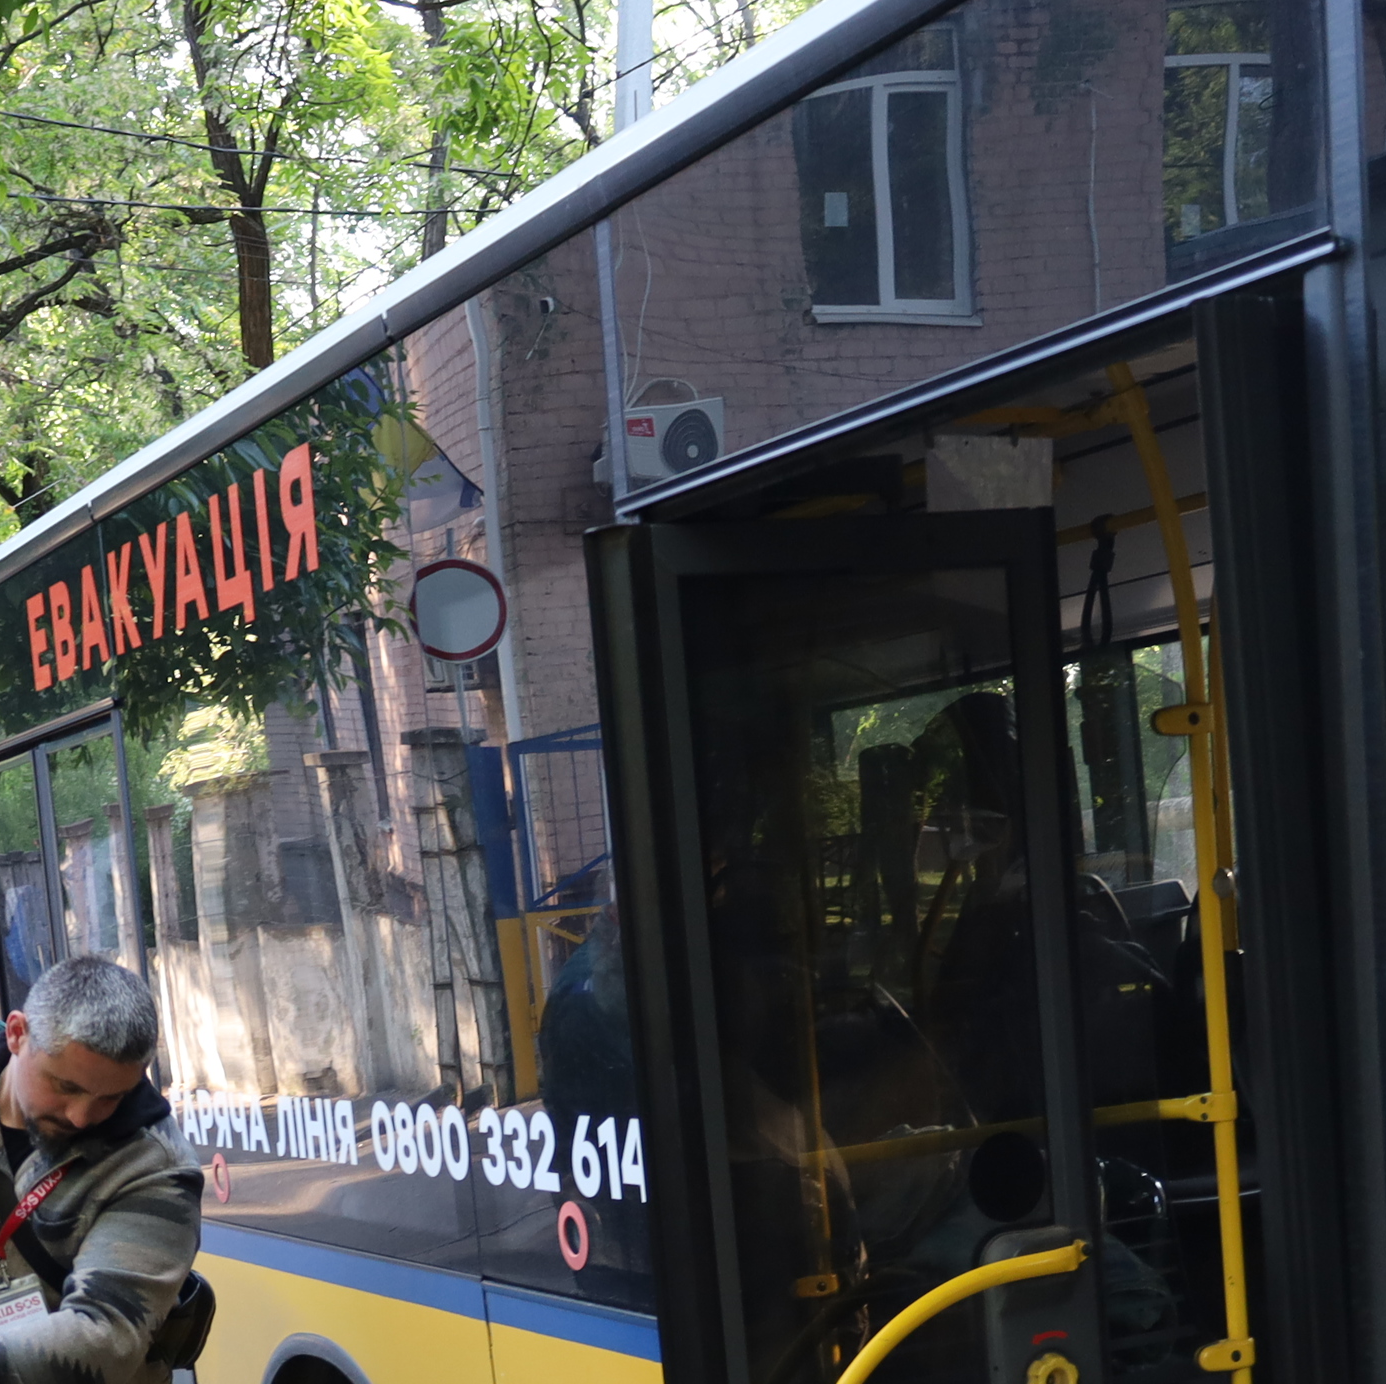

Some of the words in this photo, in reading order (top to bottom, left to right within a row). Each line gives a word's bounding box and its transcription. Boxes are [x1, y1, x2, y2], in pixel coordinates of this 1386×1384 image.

[26, 442, 319, 692] ЕВАКУАЦІЯ
[276, 1096, 358, 1166] ЛІНІЯ
[371, 1100, 470, 1181] 0800
[478, 1107, 560, 1193] 332
[572, 1115, 647, 1204] 614
[15, 1194, 39, 1218] SOS
[14, 1296, 41, 1312] SOS
